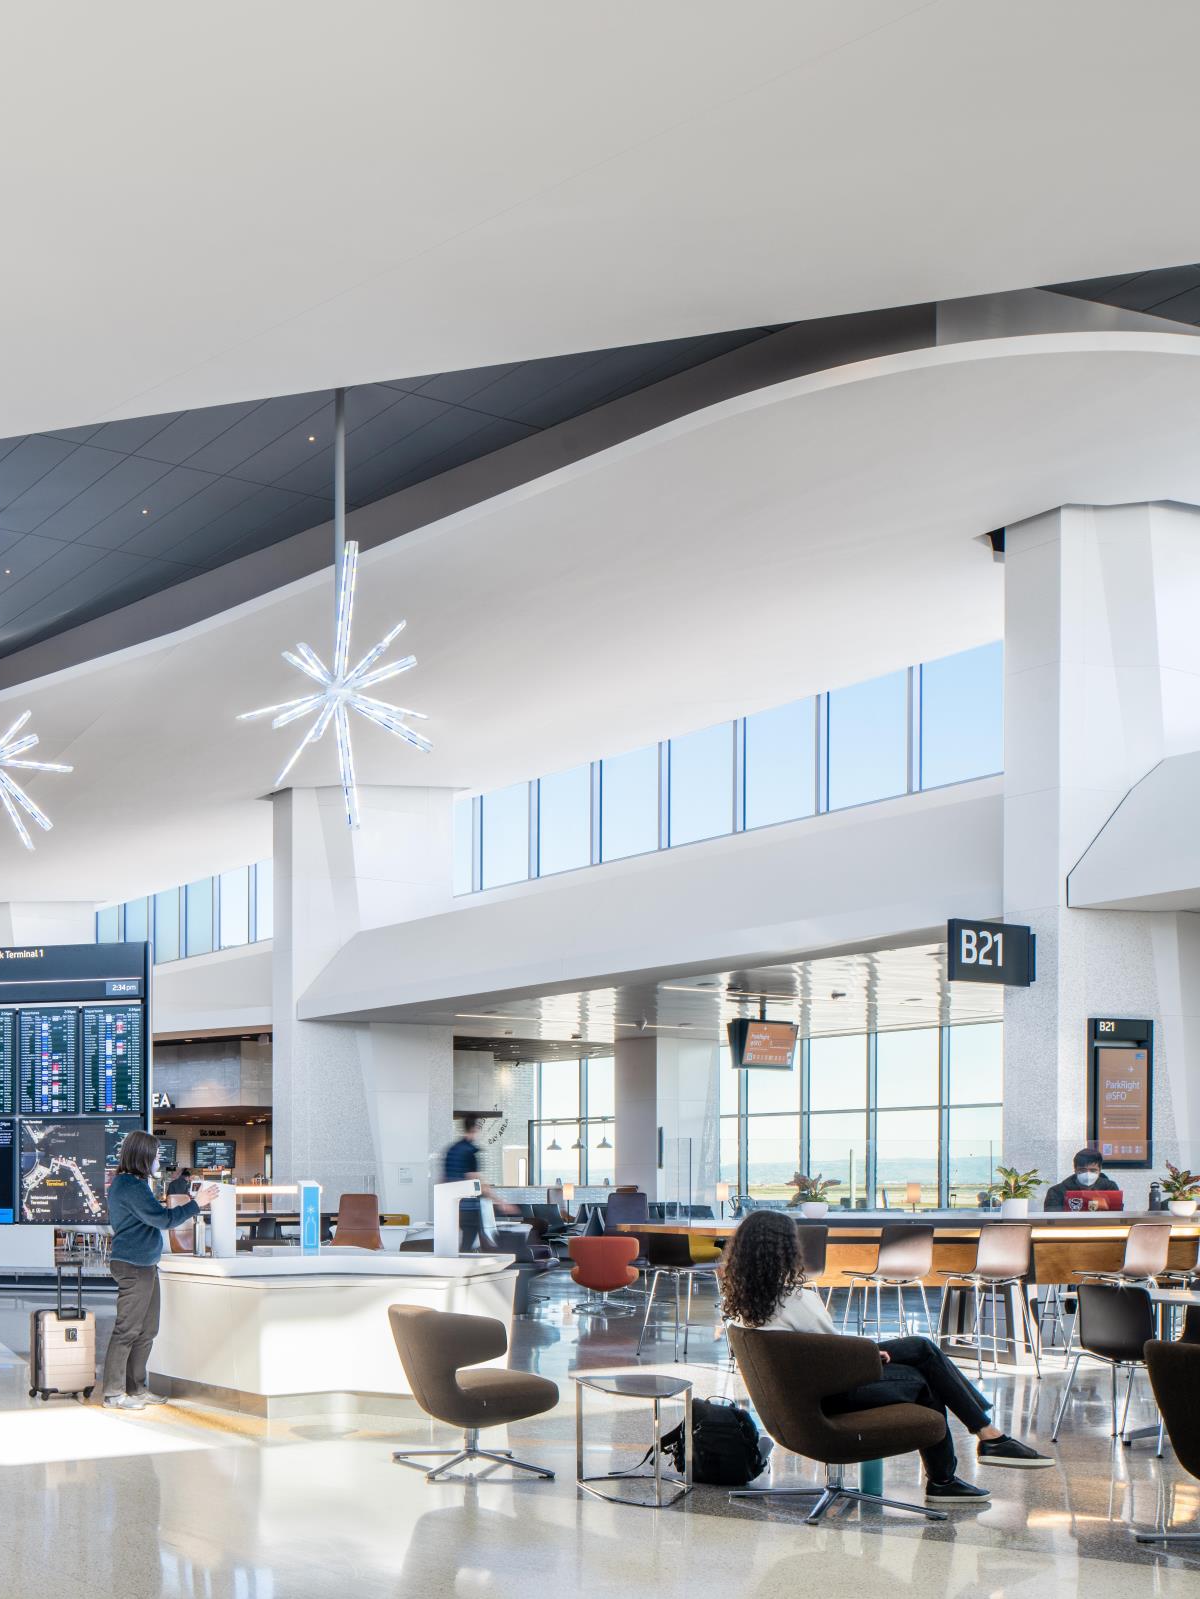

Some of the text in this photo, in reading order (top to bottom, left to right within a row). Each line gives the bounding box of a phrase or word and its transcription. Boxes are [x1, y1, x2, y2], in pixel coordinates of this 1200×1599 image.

[961, 928, 1003, 967] B21
[6, 949, 38, 959] Terminal
[39, 949, 44, 958] 1
[112, 984, 137, 993] 2:34pm
[1099, 1021, 1115, 1032] B21
